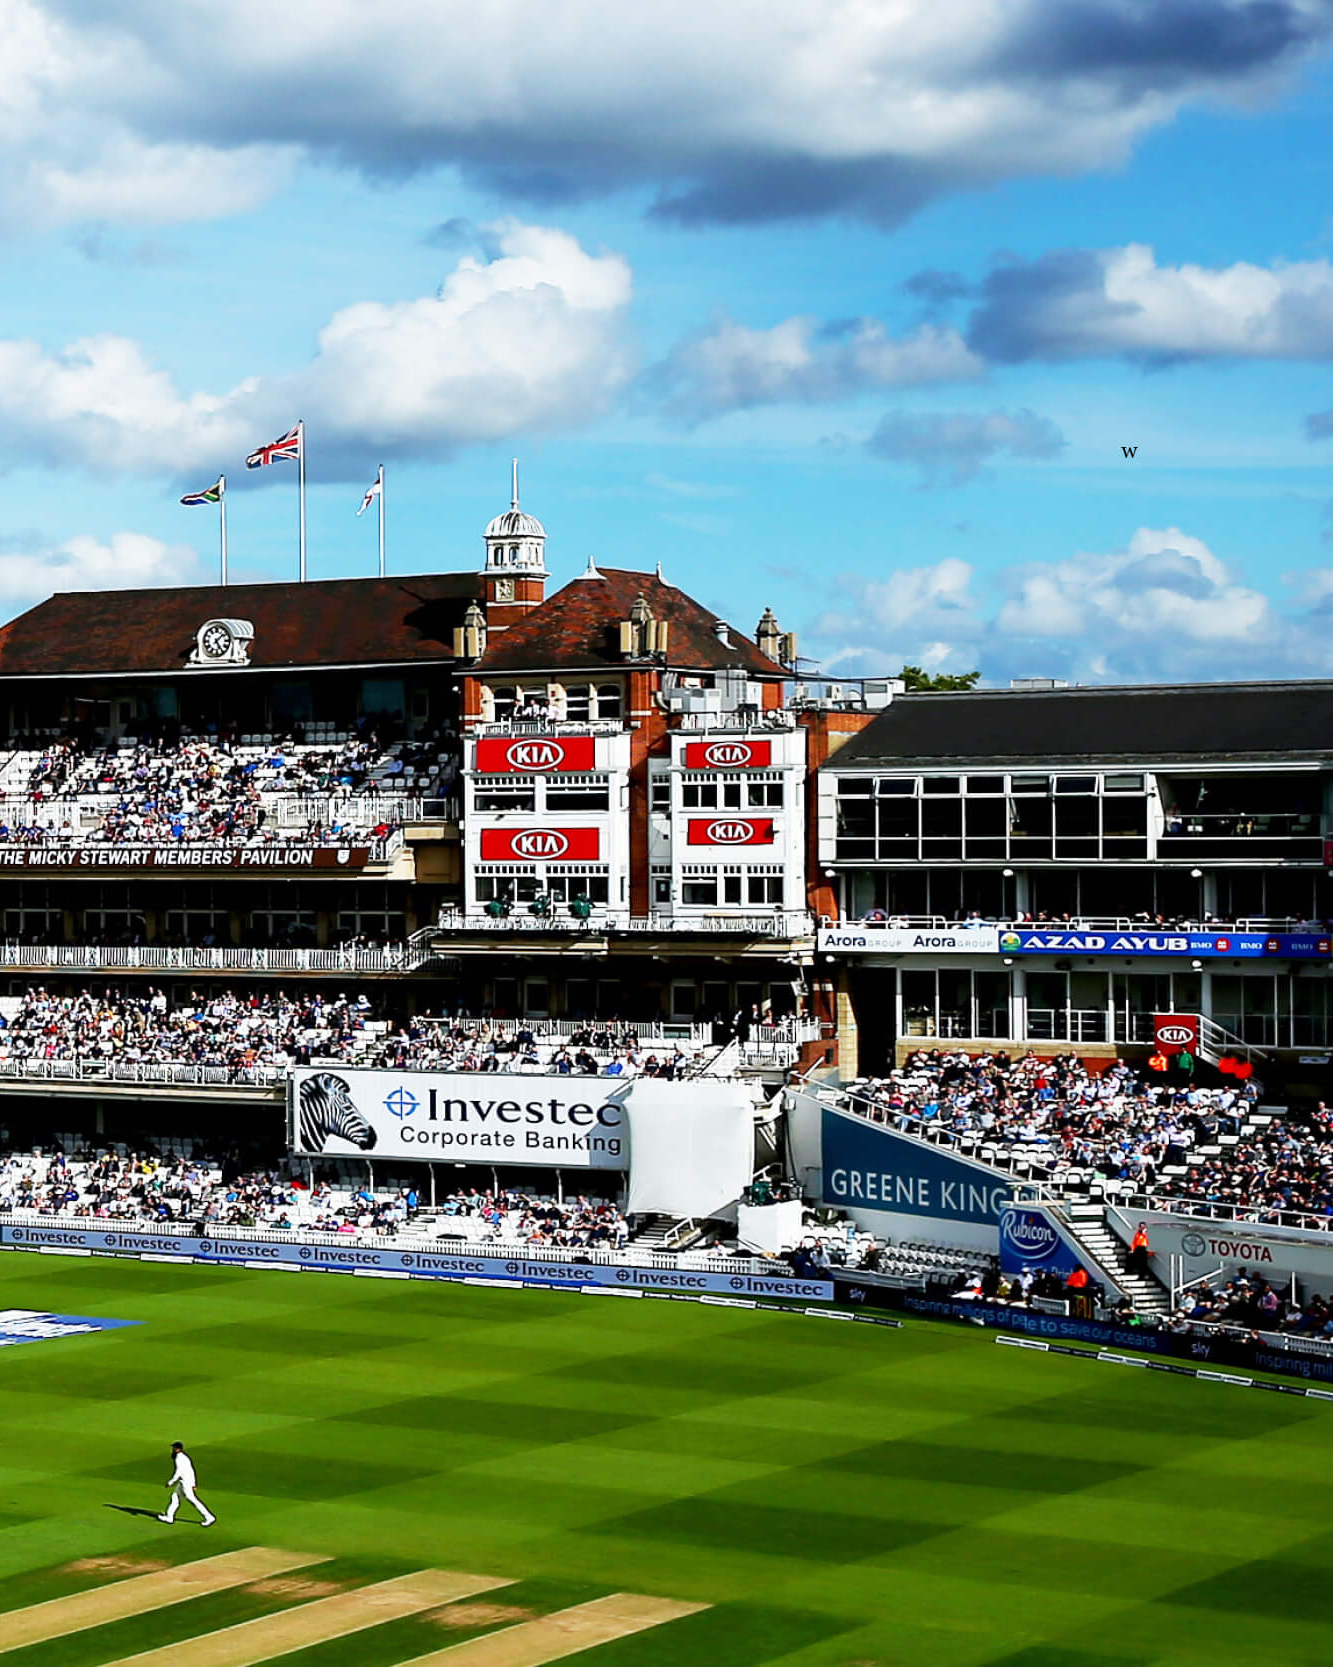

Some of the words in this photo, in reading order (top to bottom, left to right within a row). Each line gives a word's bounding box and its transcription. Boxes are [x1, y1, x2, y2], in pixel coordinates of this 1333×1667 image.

[516, 746, 554, 763] KIA
[713, 747, 744, 762] KIA
[715, 824, 746, 839] KIA
[520, 835, 559, 853] KIA
[28, 850, 76, 865] MICKY
[79, 850, 151, 865] STEWART
[153, 850, 237, 865] MEMBERS'
[239, 850, 313, 865] PAVILION
[824, 934, 867, 946] Arora
[868, 939, 902, 947] GROUP
[913, 935, 956, 947] Arora
[957, 940, 993, 948] GROUP
[1023, 936, 1106, 949] AZAD
[1110, 937, 1188, 950] AYUB
[1190, 941, 1213, 949] BMO
[1240, 942, 1263, 950] BMO
[1162, 1030, 1188, 1041] KIA
[428, 1088, 622, 1127] Investec
[400, 1125, 515, 1148] Corporate
[525, 1131, 621, 1155] Banking
[831, 1168, 930, 1207] GREENE
[1000, 1210, 1055, 1244] Rubicon
[25, 1230, 86, 1245] Investec
[118, 1234, 182, 1251] Investec
[214, 1240, 280, 1258] Investec
[314, 1248, 381, 1265] Investec
[1208, 1239, 1273, 1262] TOYOTA
[416, 1255, 484, 1273] Investec
[522, 1262, 595, 1281] Investec
[633, 1269, 707, 1288] Investec
[747, 1277, 823, 1296] Investec
[849, 1287, 866, 1301] sky
[997, 1308, 1009, 1322] of
[1040, 1318, 1058, 1333] to
[1060, 1321, 1090, 1337] save
[1092, 1326, 1112, 1340] our
[1113, 1329, 1157, 1348] oceans
[1191, 1341, 1211, 1358] sky
[1255, 1350, 1311, 1377] Inspiring
